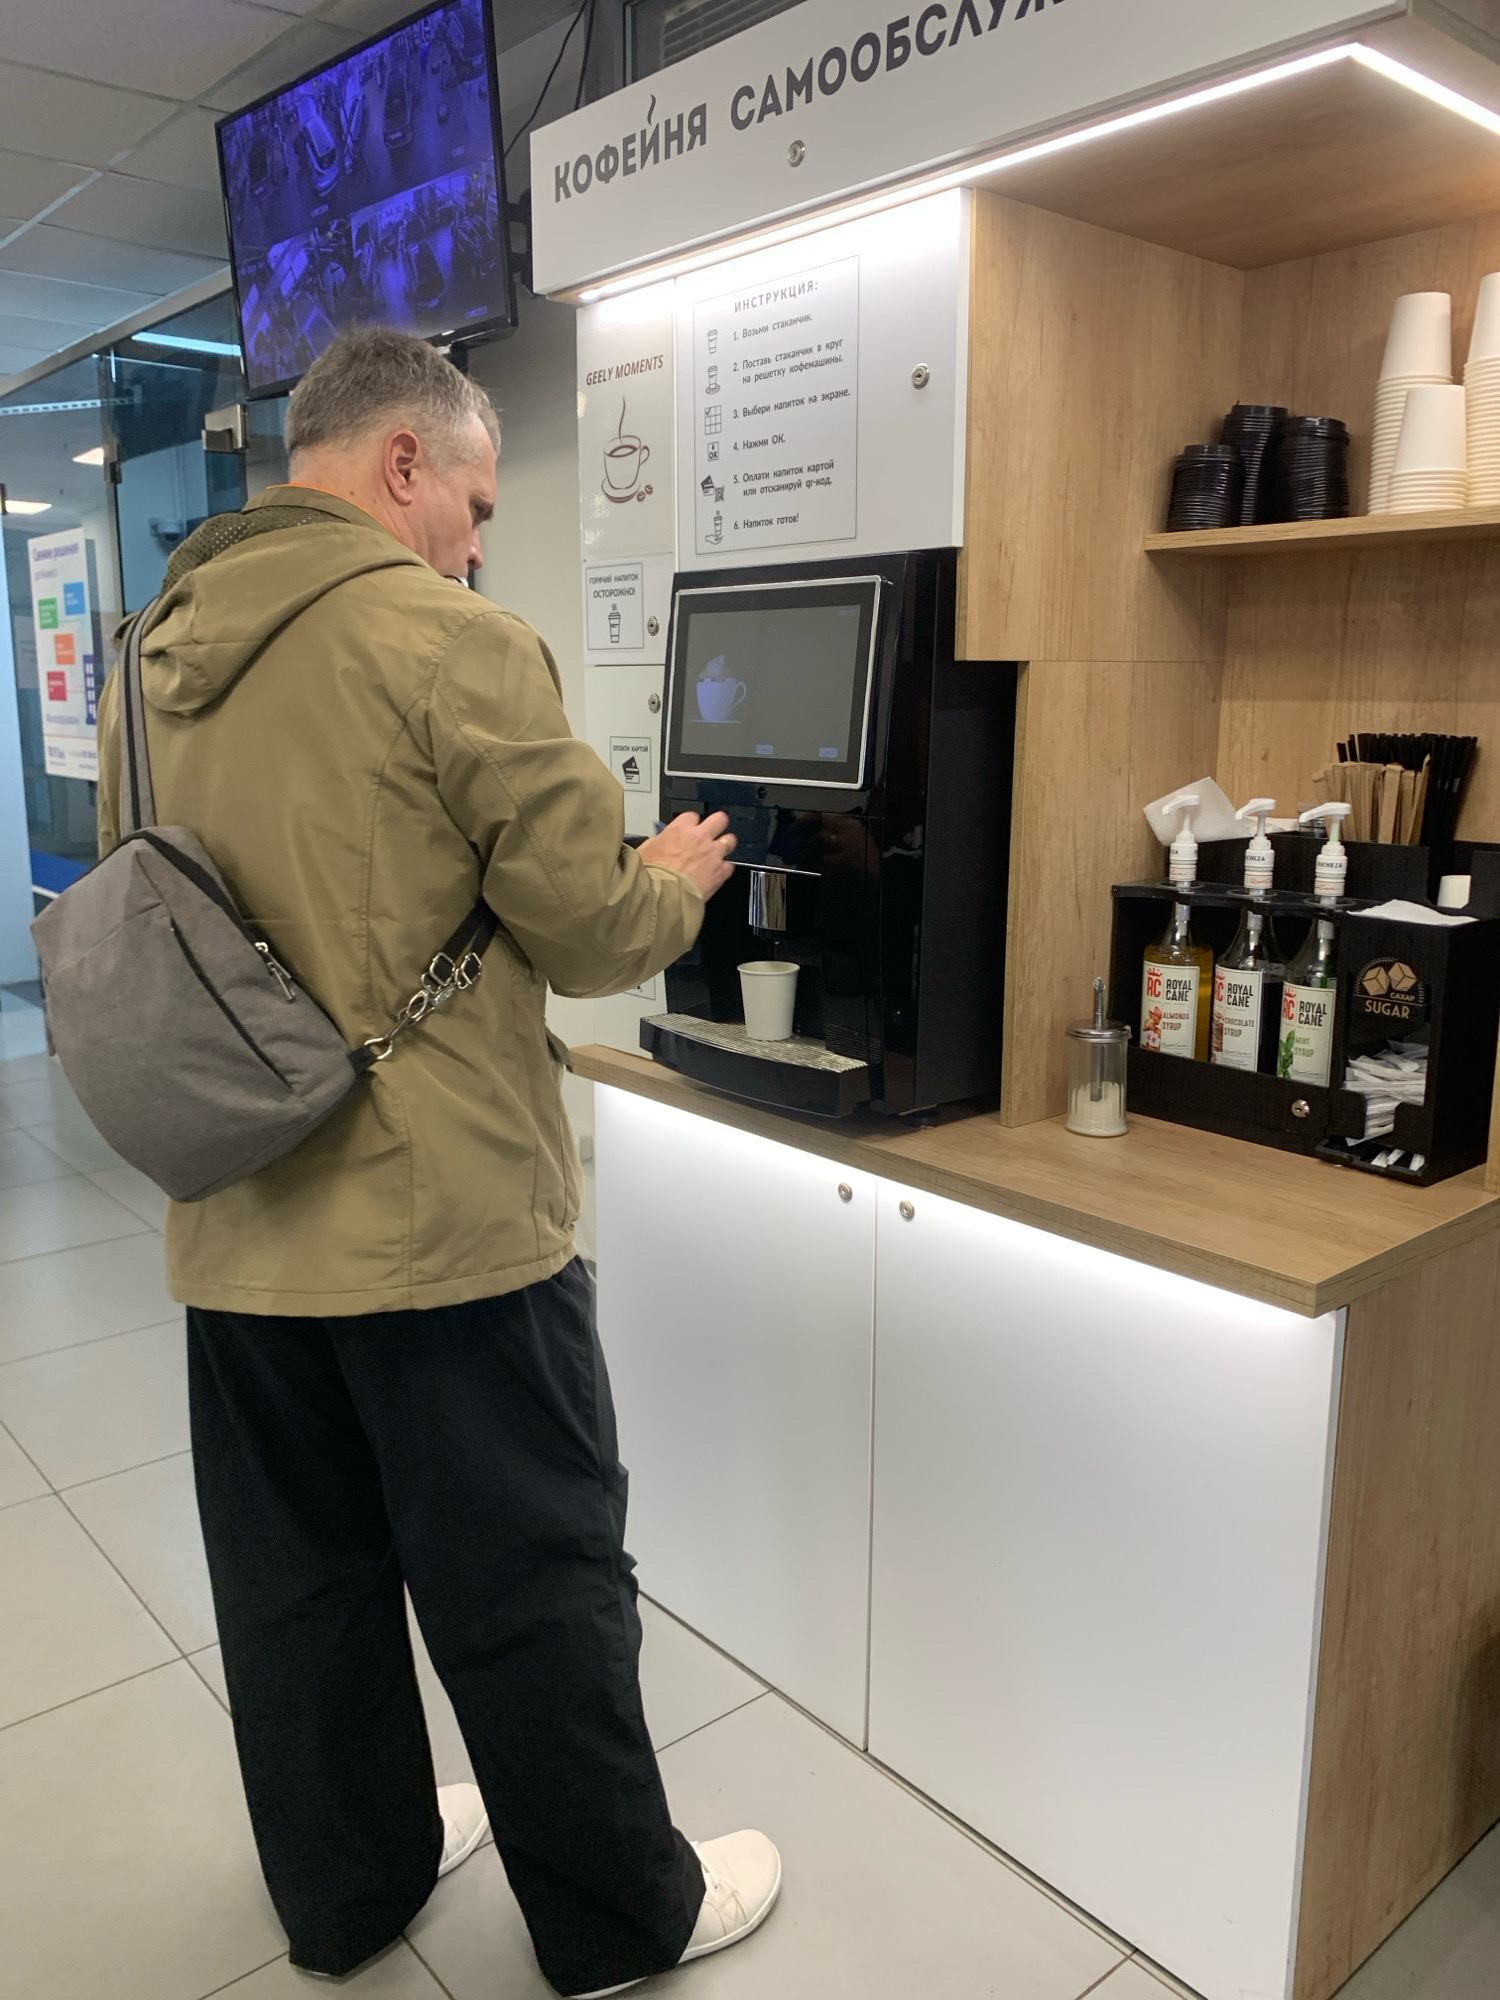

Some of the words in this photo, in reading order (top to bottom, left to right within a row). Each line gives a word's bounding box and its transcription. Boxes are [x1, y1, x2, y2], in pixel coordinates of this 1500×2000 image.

[554, 95, 707, 203] КОФЕЙНЯ
[734, 280, 819, 313] ИНСТРУКЦИЯ:
[733, 331, 739, 341] 1.
[742, 325, 769, 338] Возьми
[772, 314, 813, 331] стаканчик.
[733, 363, 739, 372] 2.
[742, 357, 771, 370] Поставь
[775, 346, 813, 362] стаканчик
[825, 339, 843, 352] круг
[586, 367, 613, 386] GEELY
[615, 354, 664, 379] MOMENTS
[742, 376, 750, 384] на
[754, 369, 786, 382] решетку
[789, 355, 843, 374] кофемашины.
[733, 409, 739, 419] 3.
[742, 405, 771, 417] Выбери
[774, 398, 805, 410] напиток
[821, 389, 850, 401] экране.
[733, 442, 739, 451] 4.
[742, 438, 768, 450] Нажми
[733, 475, 739, 484] 5.
[742, 471, 770, 483] Оплати
[773, 466, 803, 478] напиток
[807, 459, 834, 473] картой
[743, 487, 756, 496] или
[760, 479, 802, 494] отсканируй
[734, 521, 739, 530] 6.
[743, 517, 773, 529] Напиток
[777, 513, 799, 525] готов!
[614, 573, 639, 583] НАПИТОК
[593, 587, 636, 598] ОСТОРОЖНО!
[1146, 976, 1161, 997] RC
[1166, 979, 1192, 990] ROYAL
[1227, 982, 1254, 996] ROYAL
[1165, 990, 1189, 1001] CANE
[1227, 994, 1250, 1008] CANE
[1390, 992, 1415, 1001] САХАР
[1282, 997, 1295, 1020] RC
[1299, 1001, 1327, 1015] ROYAL
[1365, 1000, 1410, 1019] SUGAR
[1163, 1012, 1190, 1020] ALMONDS
[1225, 1017, 1255, 1027] CHOCOLATE
[1298, 1012, 1323, 1026] CANE
[1162, 1021, 1182, 1031] SYRUP
[1224, 1027, 1242, 1038] SYRUP
[1295, 1047, 1315, 1058] SYRUP
